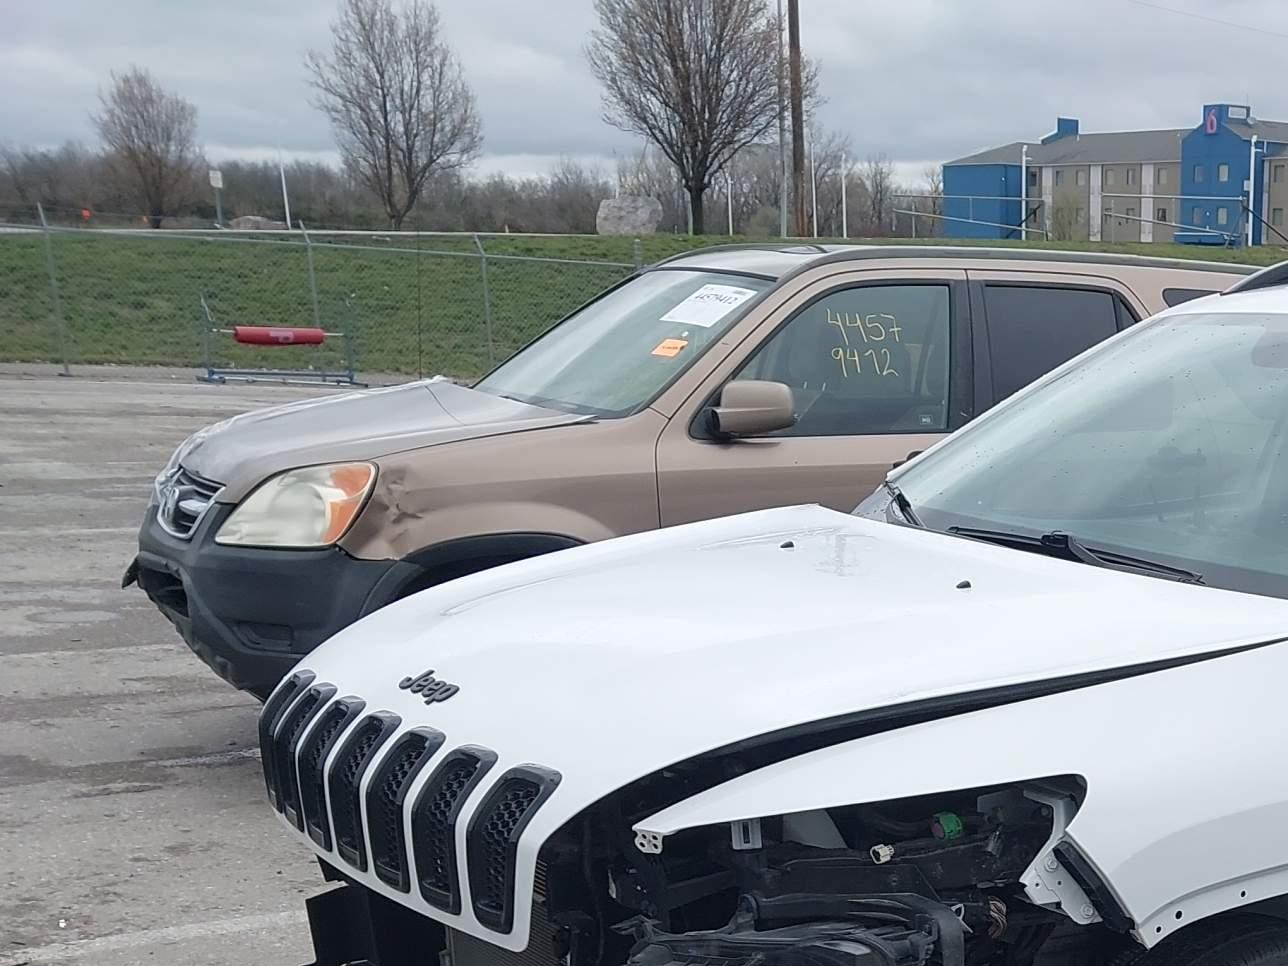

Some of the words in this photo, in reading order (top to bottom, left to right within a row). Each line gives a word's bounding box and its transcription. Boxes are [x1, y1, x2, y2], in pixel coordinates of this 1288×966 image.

[1206, 107, 1217, 134] 6
[827, 308, 902, 345] 4457
[831, 347, 899, 377] 9412
[399, 669, 460, 705] Jeep
